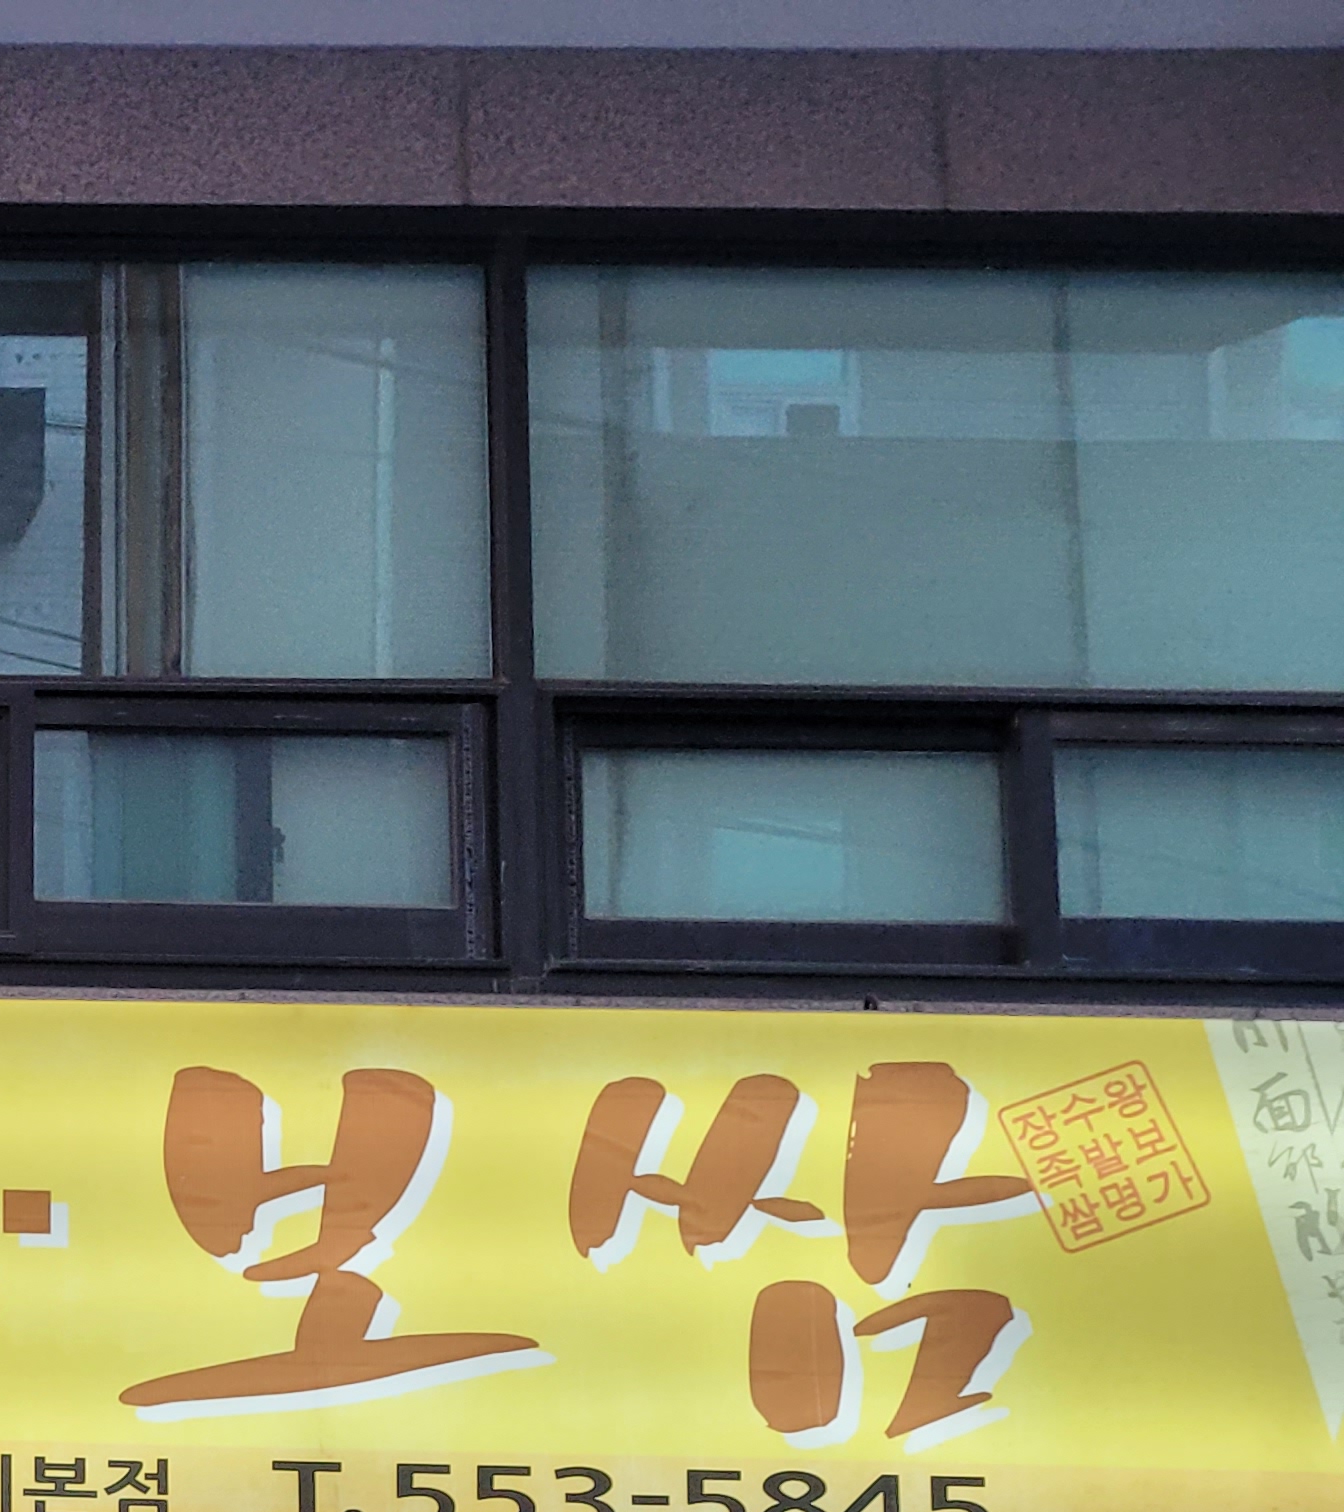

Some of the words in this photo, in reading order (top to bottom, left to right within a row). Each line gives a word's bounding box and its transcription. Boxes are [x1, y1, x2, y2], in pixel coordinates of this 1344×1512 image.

[1012, 1073, 1148, 1149] 장수왕
[1038, 1120, 1178, 1187] 족발보
[1060, 1161, 1196, 1240] 쌈명가
